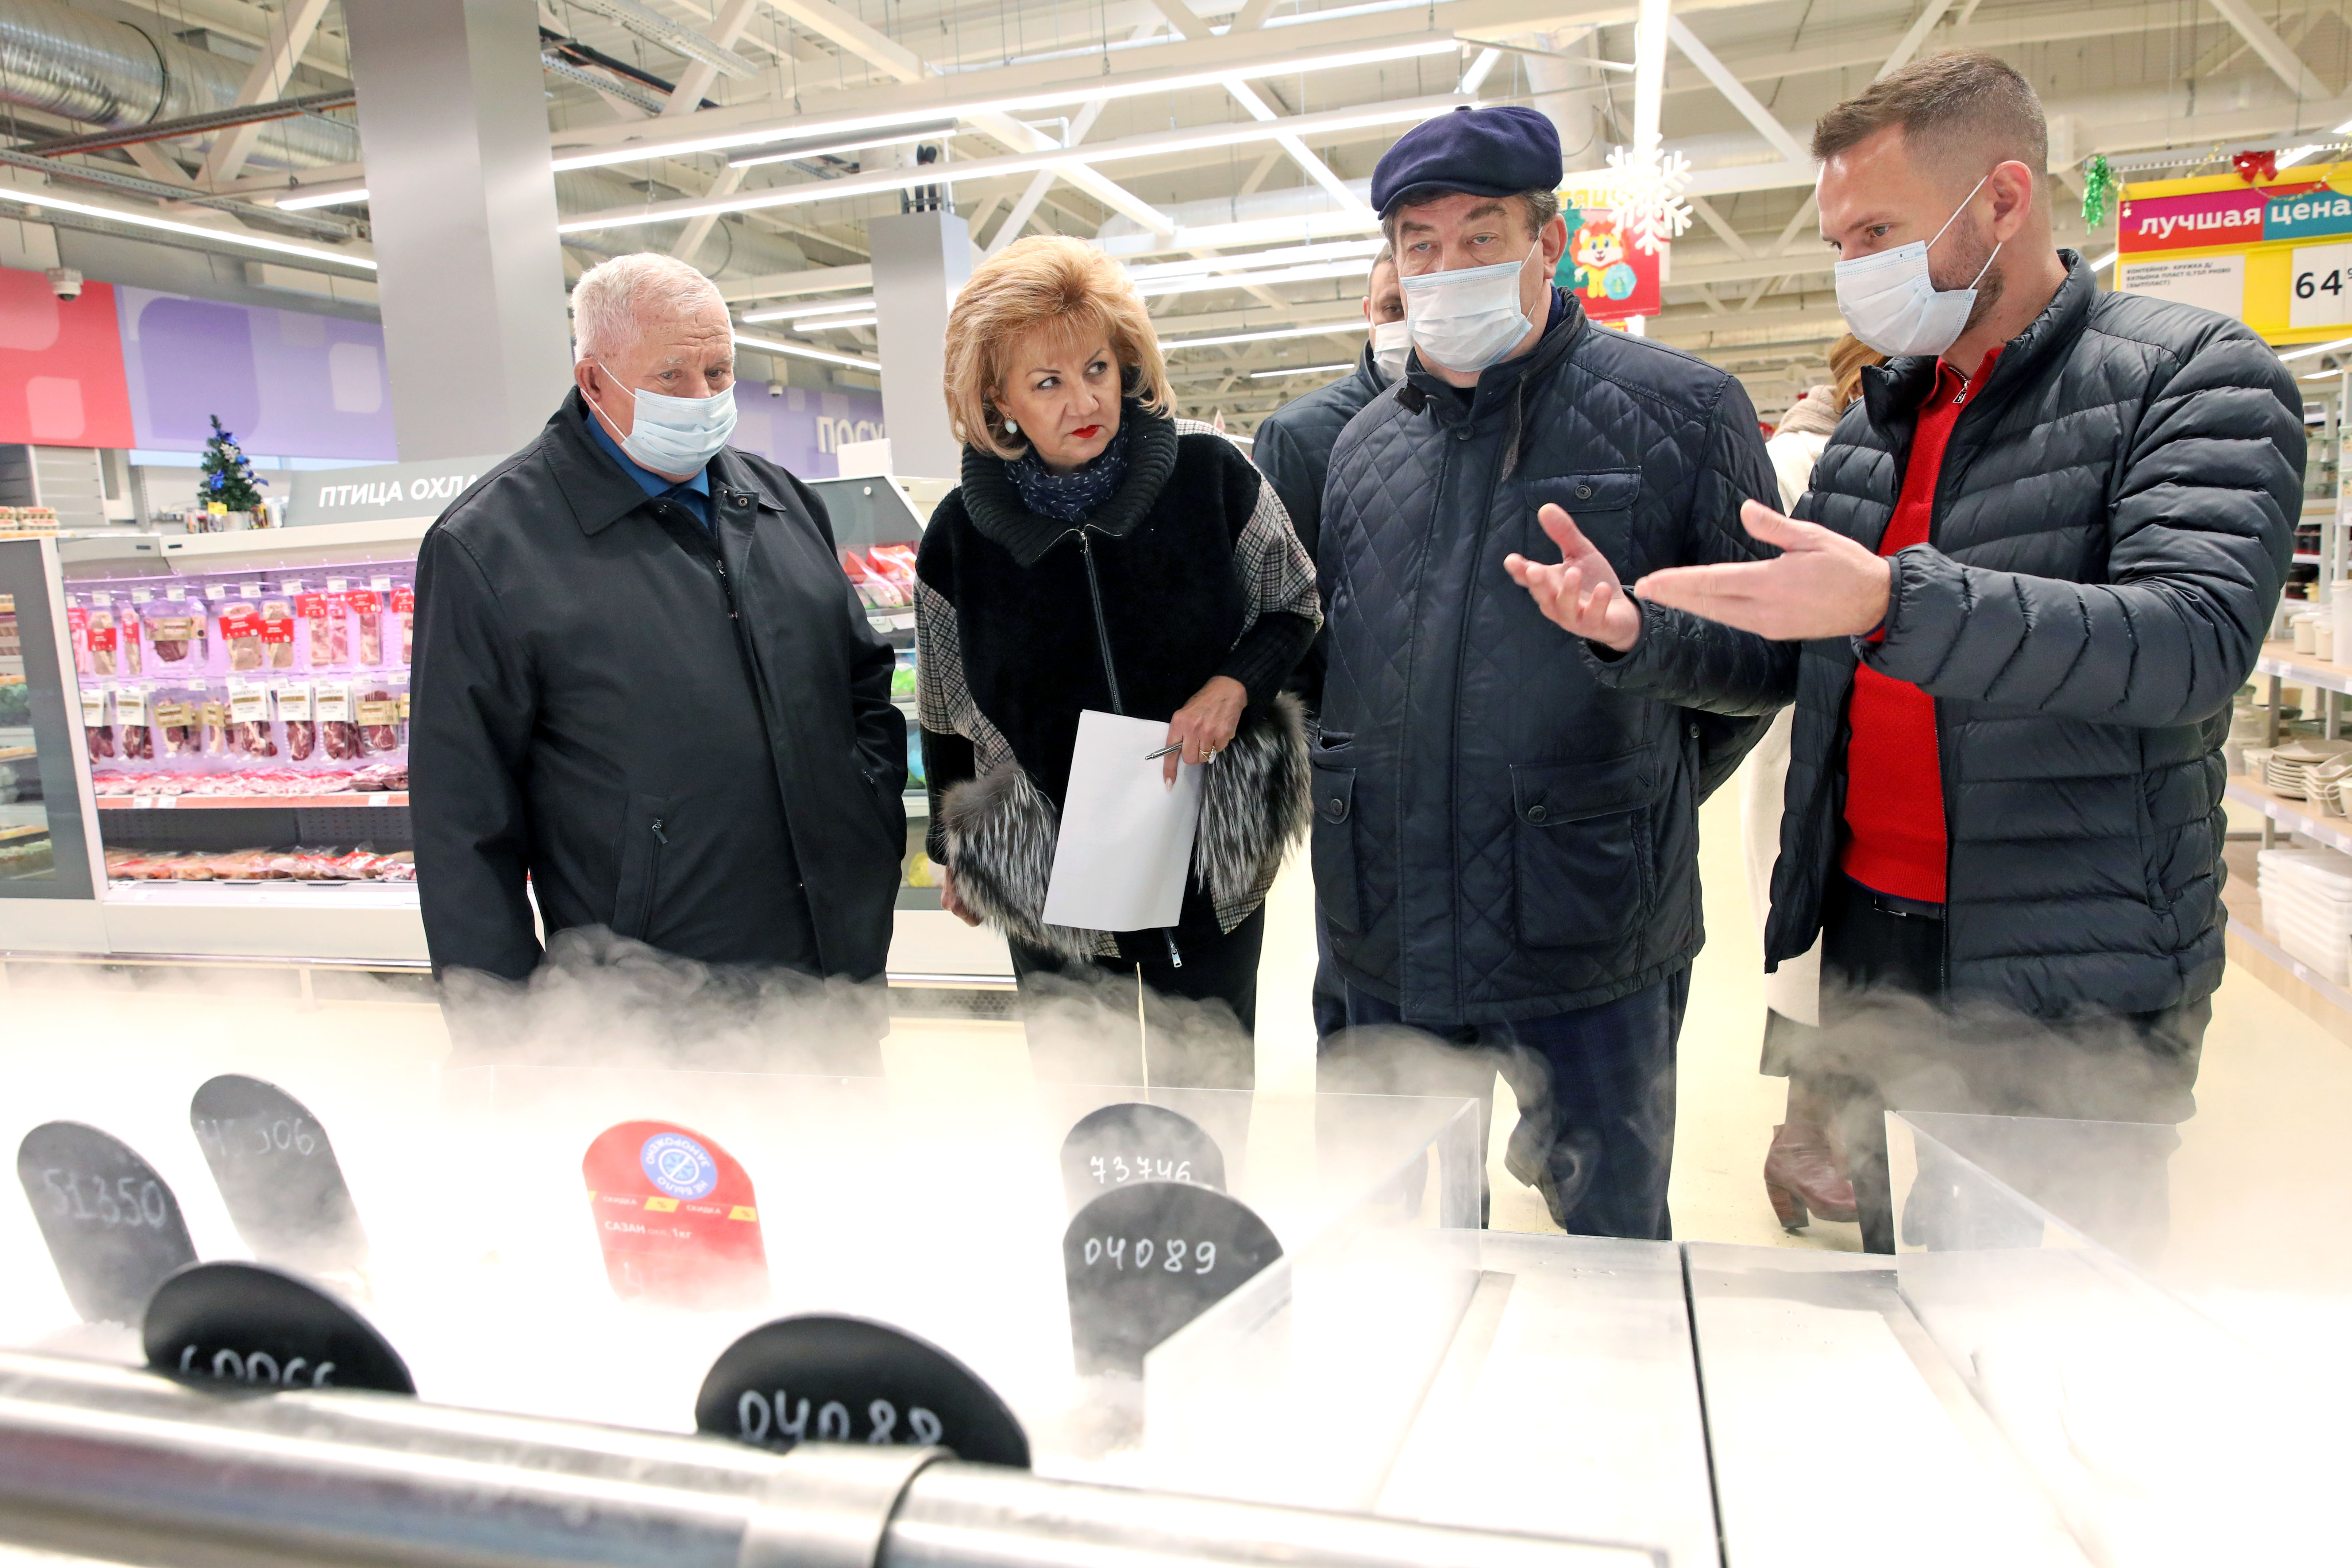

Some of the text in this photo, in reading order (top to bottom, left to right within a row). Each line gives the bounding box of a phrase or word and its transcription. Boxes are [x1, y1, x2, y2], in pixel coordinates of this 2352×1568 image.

[2139, 198, 2352, 239] лучшая цена
[319, 481, 403, 507] ПТИЦА
[645, 1137, 710, 1167] ЗАМОРОЖЕНО
[1090, 1156, 1191, 1184] 73746
[43, 1169, 166, 1229] 51350
[657, 1176, 709, 1196] НЕ БЫЛО
[603, 1196, 638, 1205] СКИДКА
[686, 1204, 722, 1214] СКИДКА
[605, 1221, 645, 1234] САЗАН
[1084, 1235, 1217, 1275] 04089
